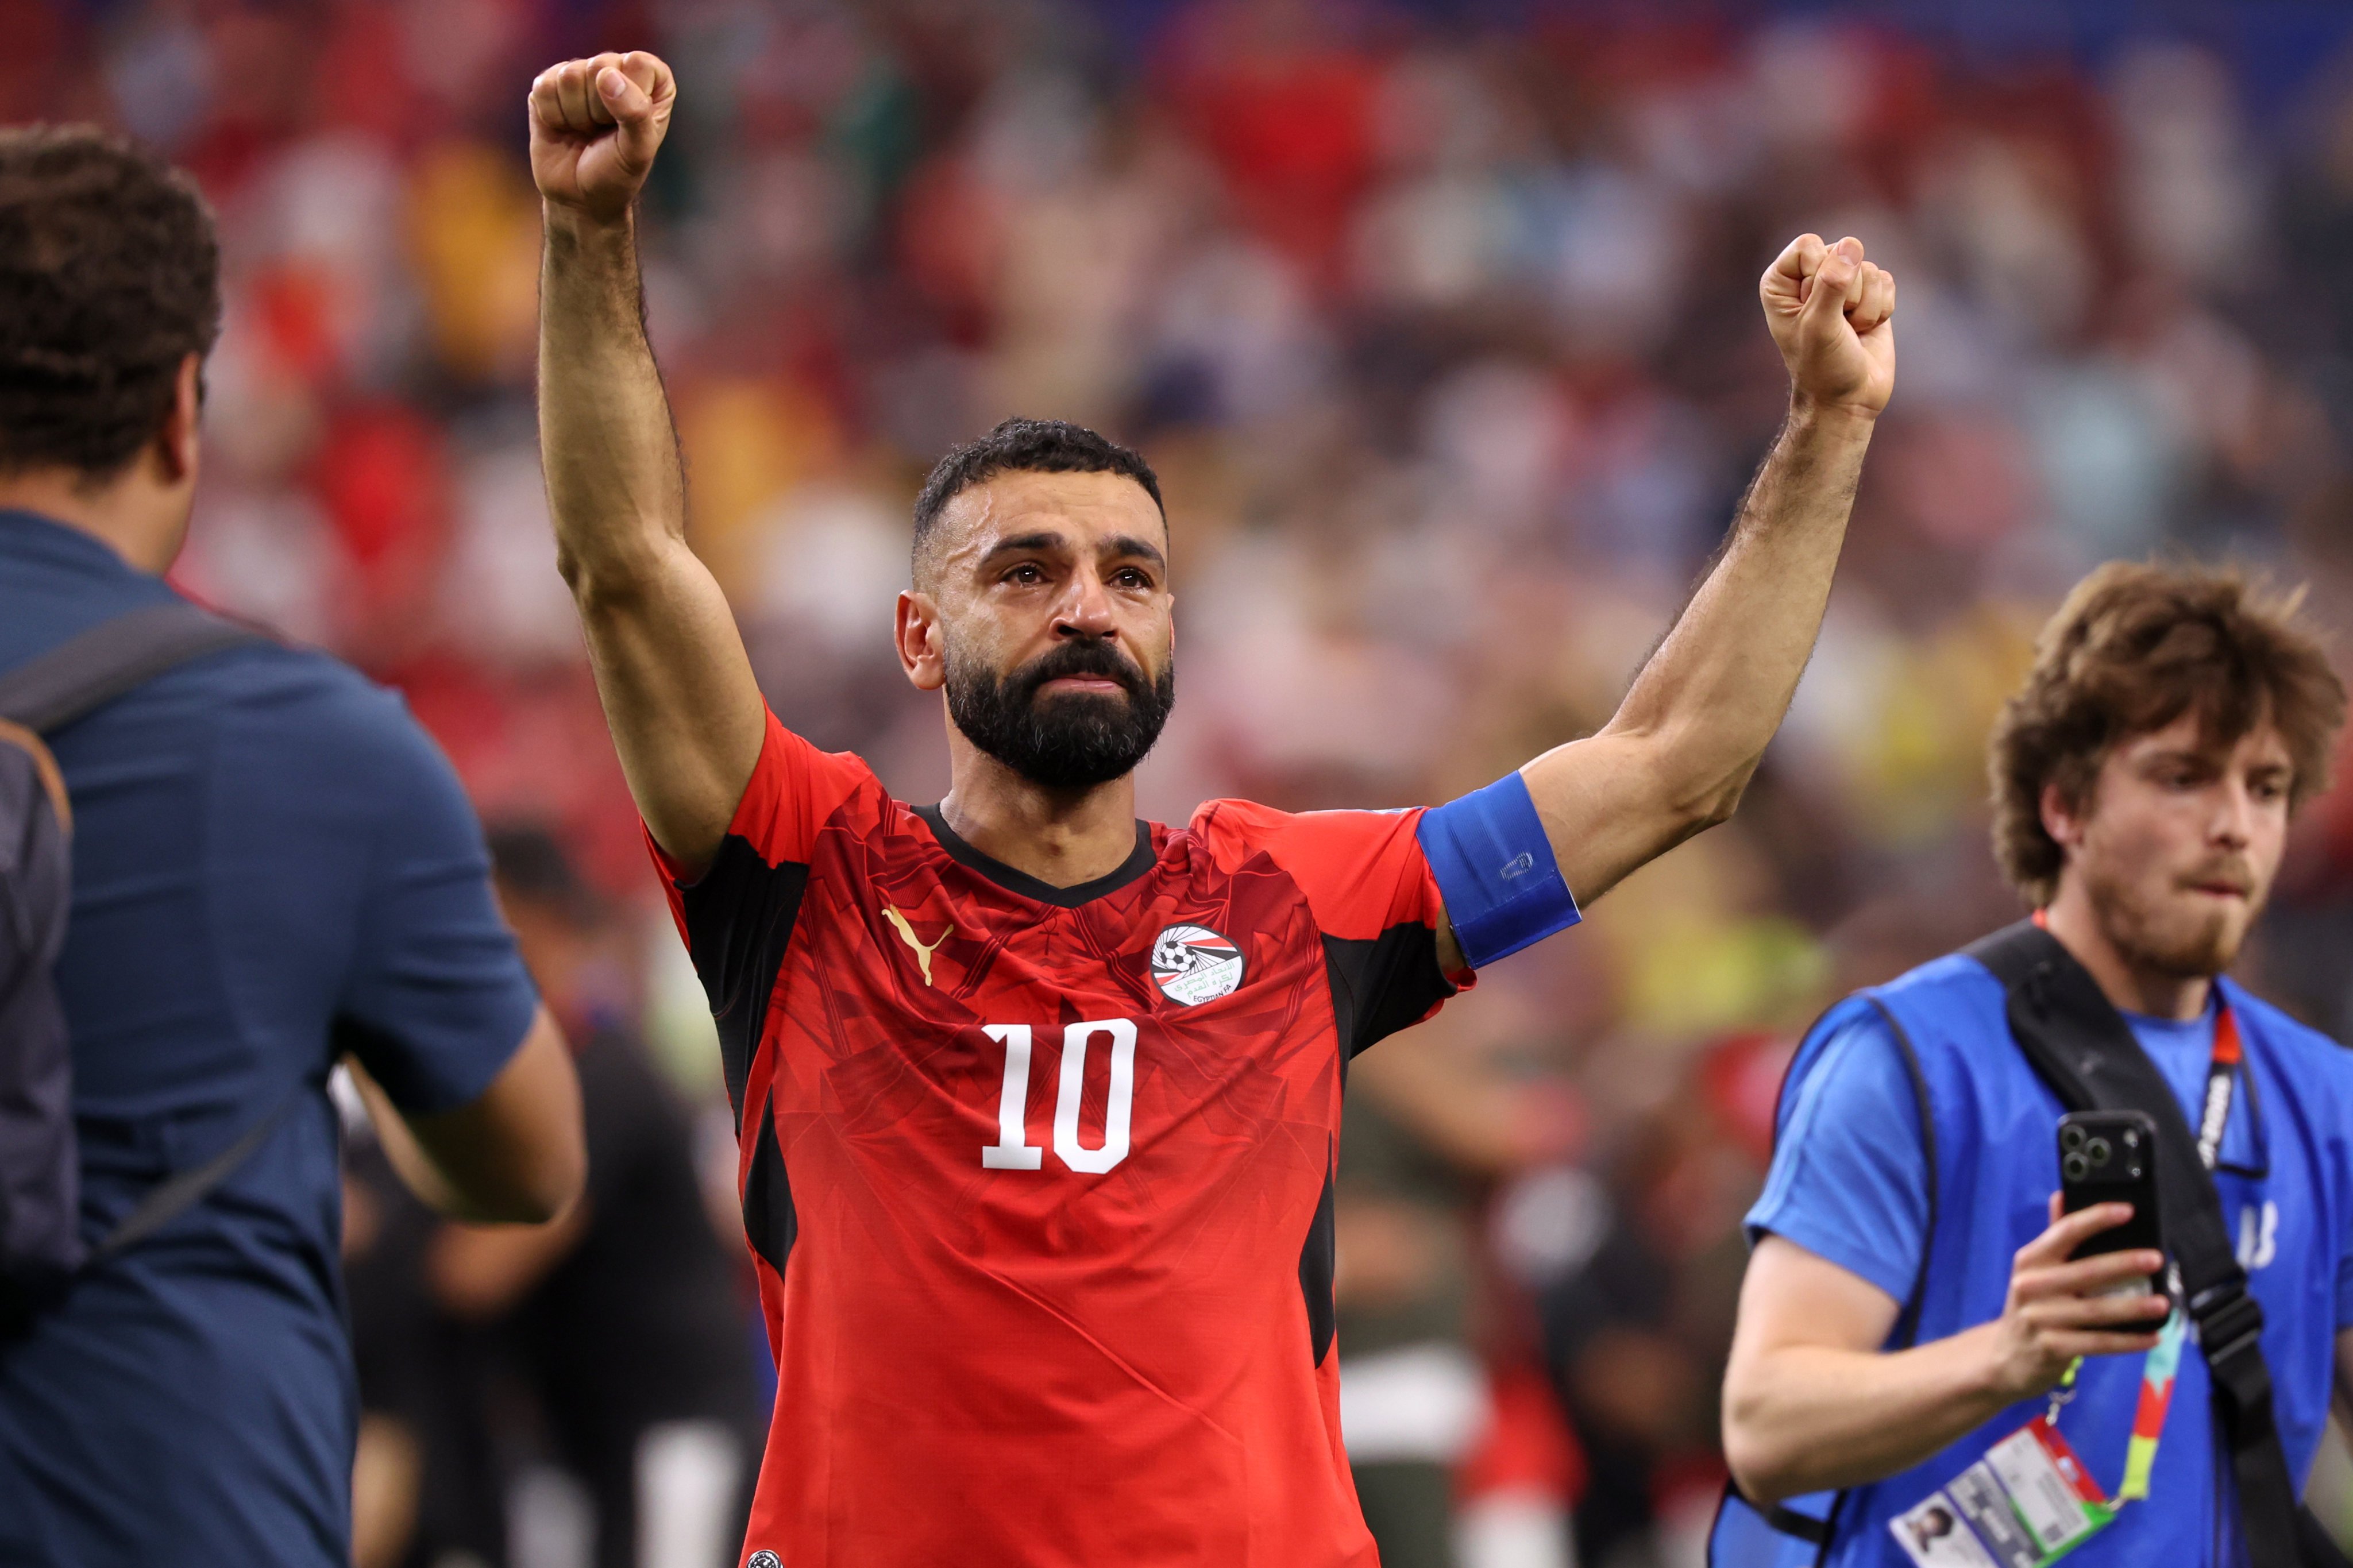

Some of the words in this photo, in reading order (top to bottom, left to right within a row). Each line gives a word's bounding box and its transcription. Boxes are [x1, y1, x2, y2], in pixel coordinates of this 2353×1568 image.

[1193, 990, 1224, 1003] EGYPTIAN
[1223, 984, 1231, 993] FA
[981, 1018, 1137, 1174] 10
